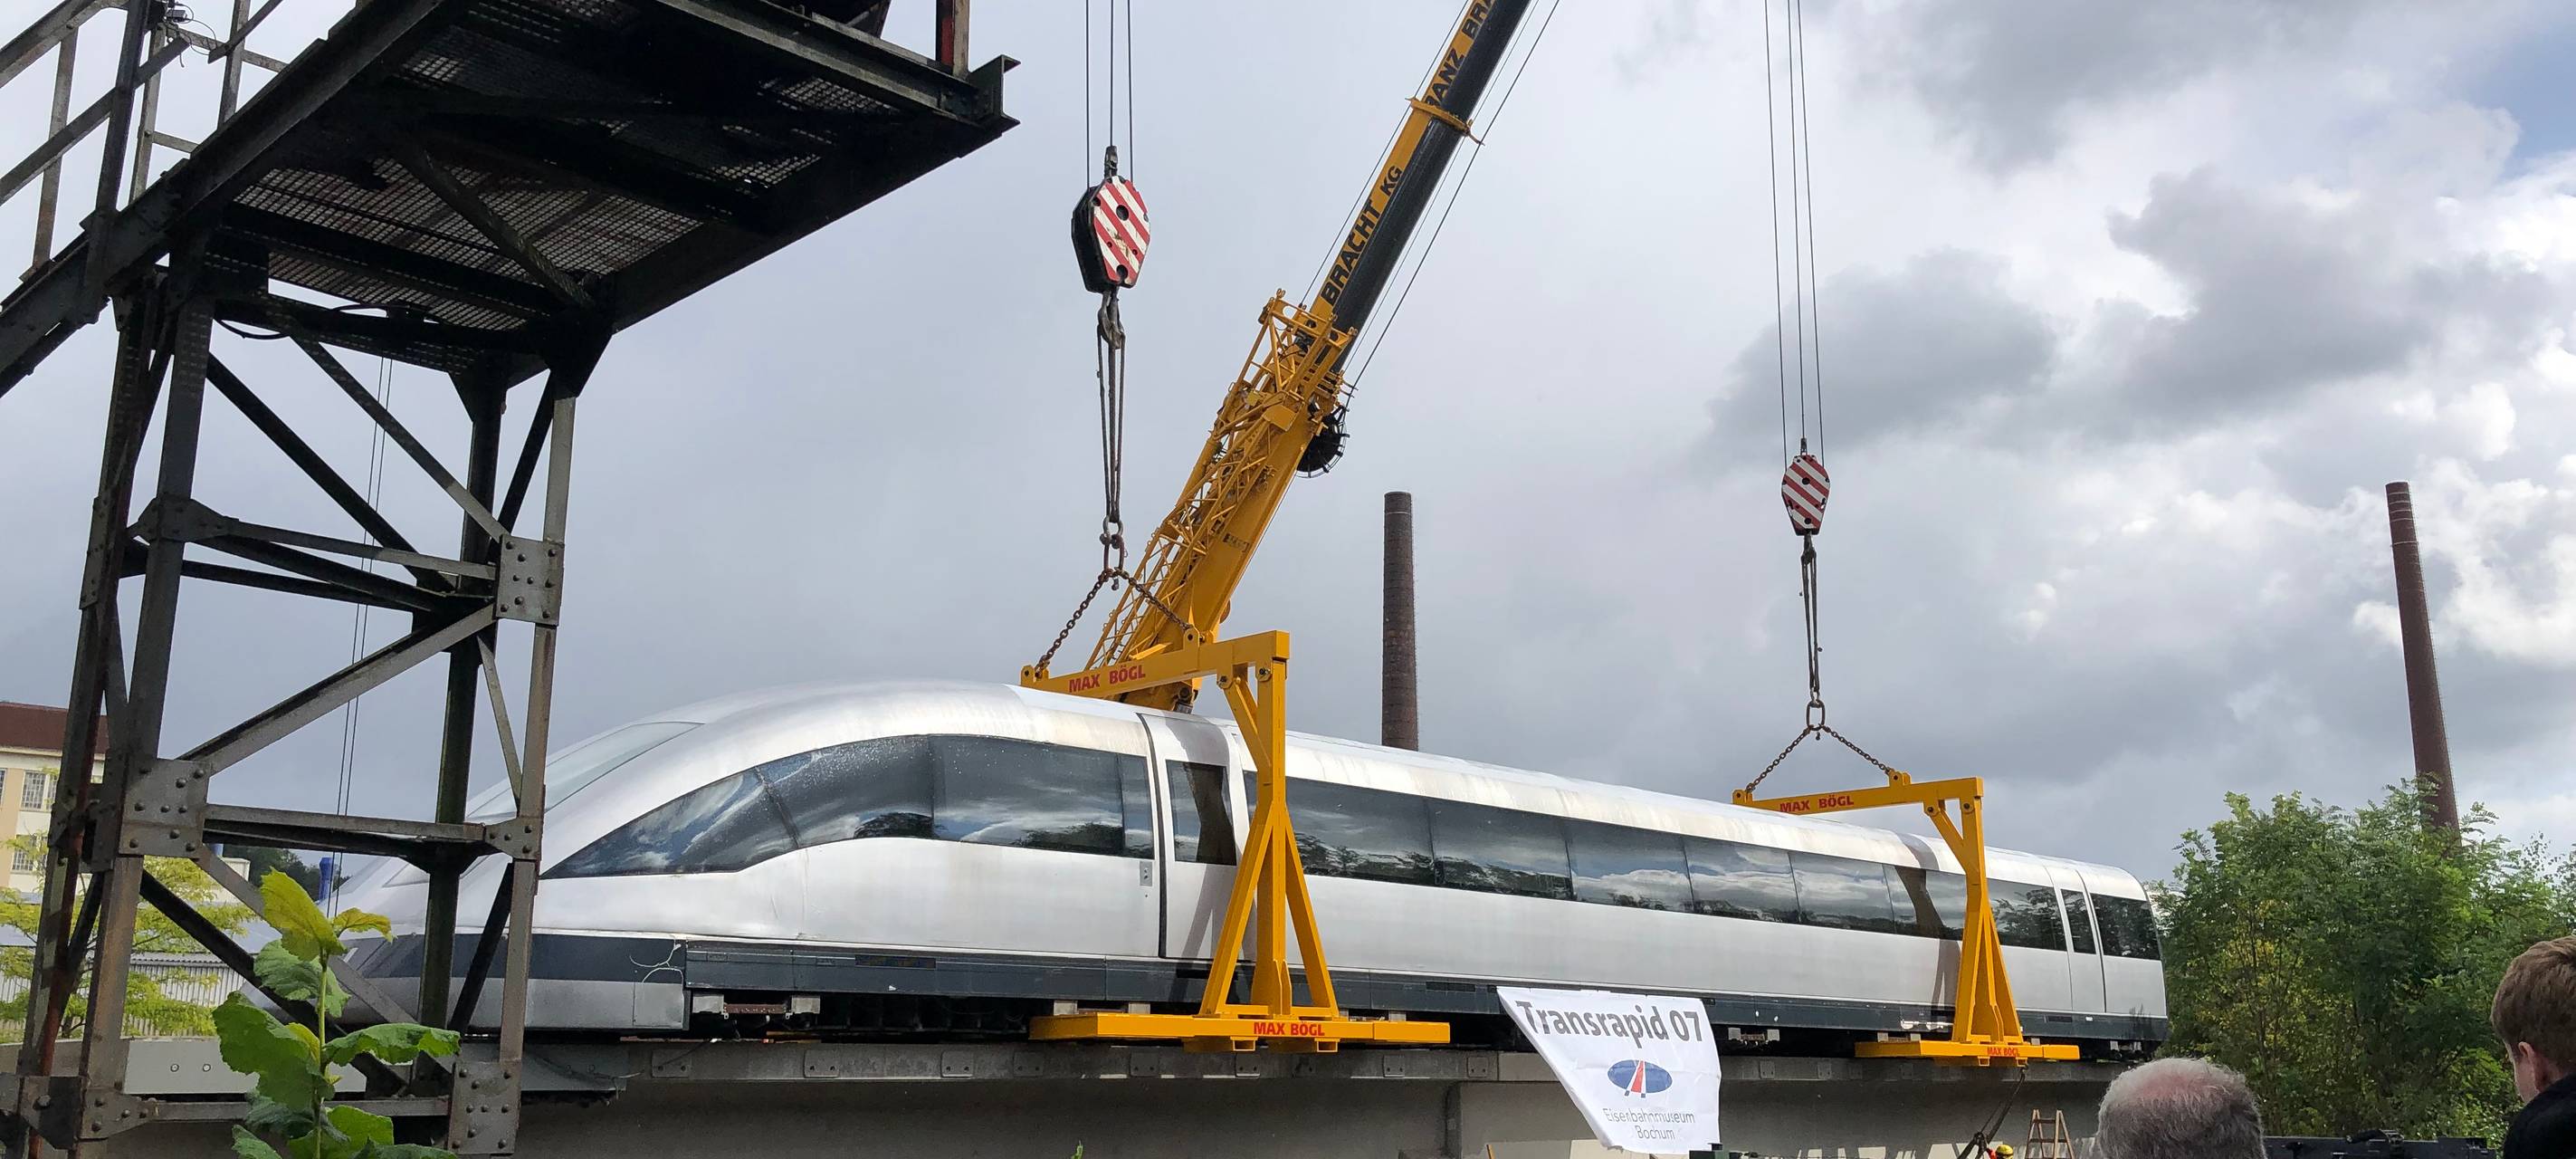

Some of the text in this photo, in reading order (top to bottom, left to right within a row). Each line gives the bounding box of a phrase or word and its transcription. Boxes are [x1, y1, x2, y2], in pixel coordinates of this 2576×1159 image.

[1321, 166, 1403, 306] BRACHT KG
[1069, 664, 1146, 693] MAX BÖGL
[1779, 794, 1854, 812] MAX BÖGL
[1254, 1021, 1285, 1034] MAX
[1515, 1001, 1703, 1049] Transrapid 07
[1602, 1107, 1695, 1124] Eisenbahnmuseum
[1635, 1125, 1675, 1140] Bochum
